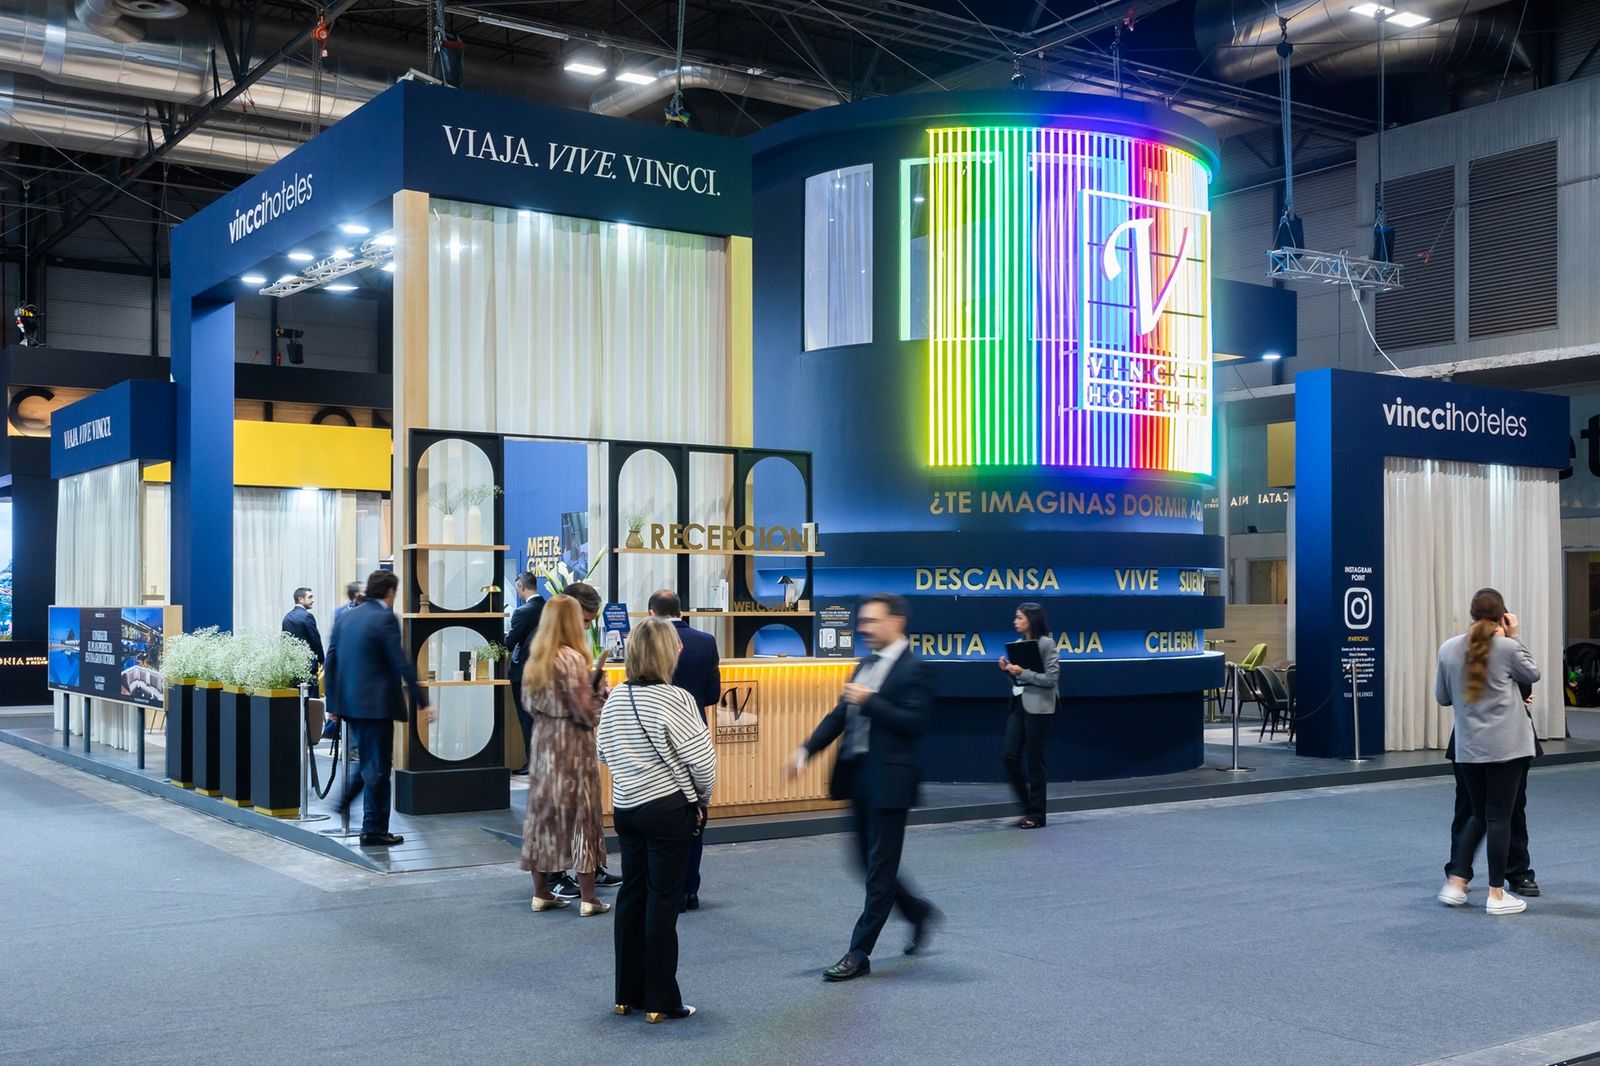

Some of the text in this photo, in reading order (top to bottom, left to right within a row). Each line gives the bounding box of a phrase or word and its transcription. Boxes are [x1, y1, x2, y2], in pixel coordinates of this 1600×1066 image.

[442, 124, 721, 197] VIAJA. VIVE. VINCCI.
[929, 491, 971, 515] ¿TE
[981, 490, 1116, 516] IMAGINAS
[1123, 493, 1188, 519] DORMIR
[650, 523, 810, 552] RECEPCION
[916, 568, 1060, 591] DESCANSA
[1115, 569, 1158, 590] VIVE
[1146, 632, 1199, 654] CELEBRA
